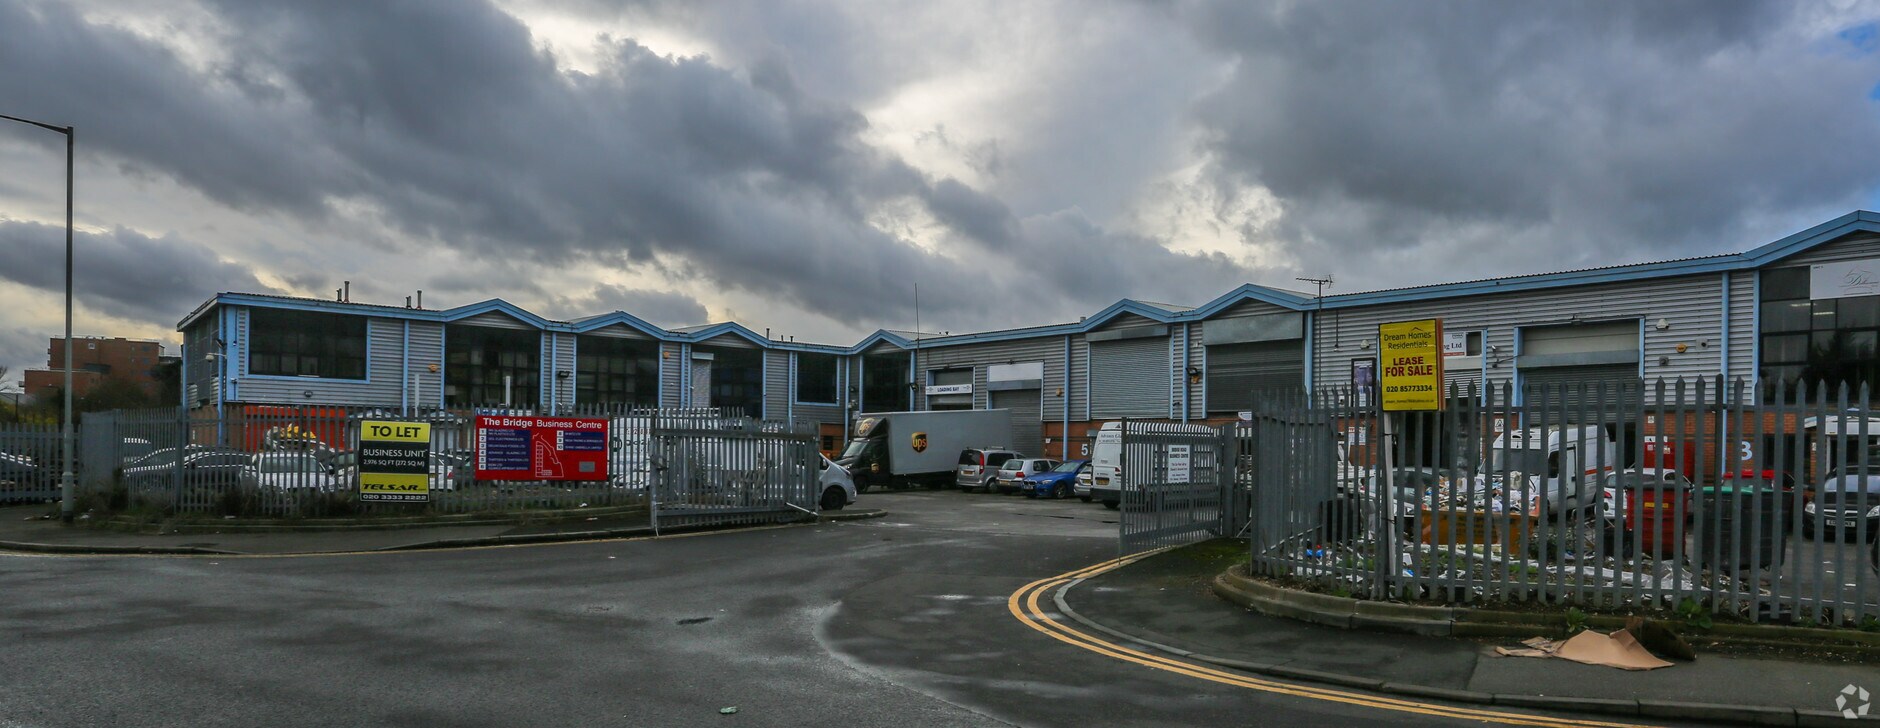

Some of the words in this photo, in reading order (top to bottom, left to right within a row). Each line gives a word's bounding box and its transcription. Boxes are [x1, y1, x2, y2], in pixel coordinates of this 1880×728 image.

[1384, 333, 1406, 341] Dream
[1388, 341, 1428, 350] Residentials
[1393, 356, 1424, 366] LEASE
[1386, 366, 1404, 377] FOR
[1408, 365, 1433, 376] SALE
[483, 418, 500, 426] The
[503, 418, 532, 428] Bridge
[537, 420, 572, 428] Business
[576, 421, 602, 429] Centre
[371, 426, 391, 437] TO
[396, 426, 421, 438] LET
[912, 439, 927, 450] ups
[1081, 444, 1088, 456] 5
[363, 449, 402, 457] BUSINESS
